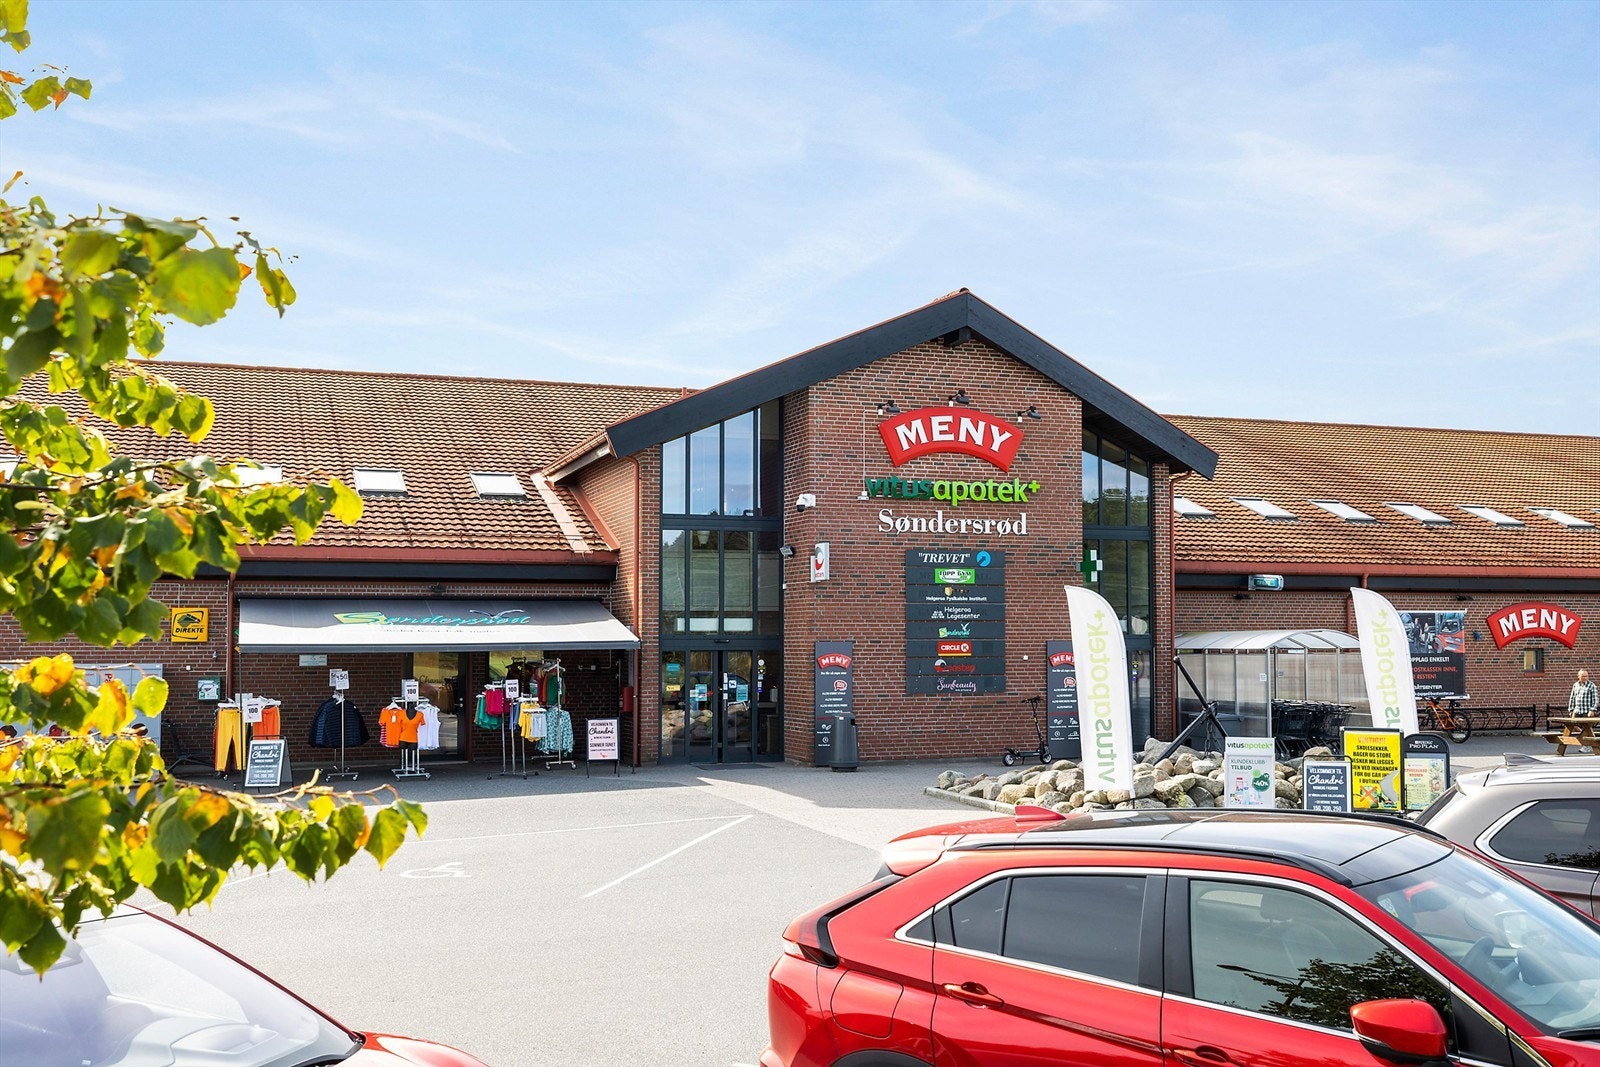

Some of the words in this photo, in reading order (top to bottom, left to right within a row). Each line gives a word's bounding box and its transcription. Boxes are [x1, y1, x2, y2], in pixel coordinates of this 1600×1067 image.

[895, 415, 1013, 453] MENY
[878, 508, 1029, 538] Søndersrød
[944, 606, 972, 614] Helgeroa
[947, 612, 980, 621] Legesenter
[1498, 608, 1576, 638] MENY
[821, 656, 849, 666] MENY
[937, 679, 977, 693] Sunbeauty
[1308, 774, 1345, 785] Chandré
